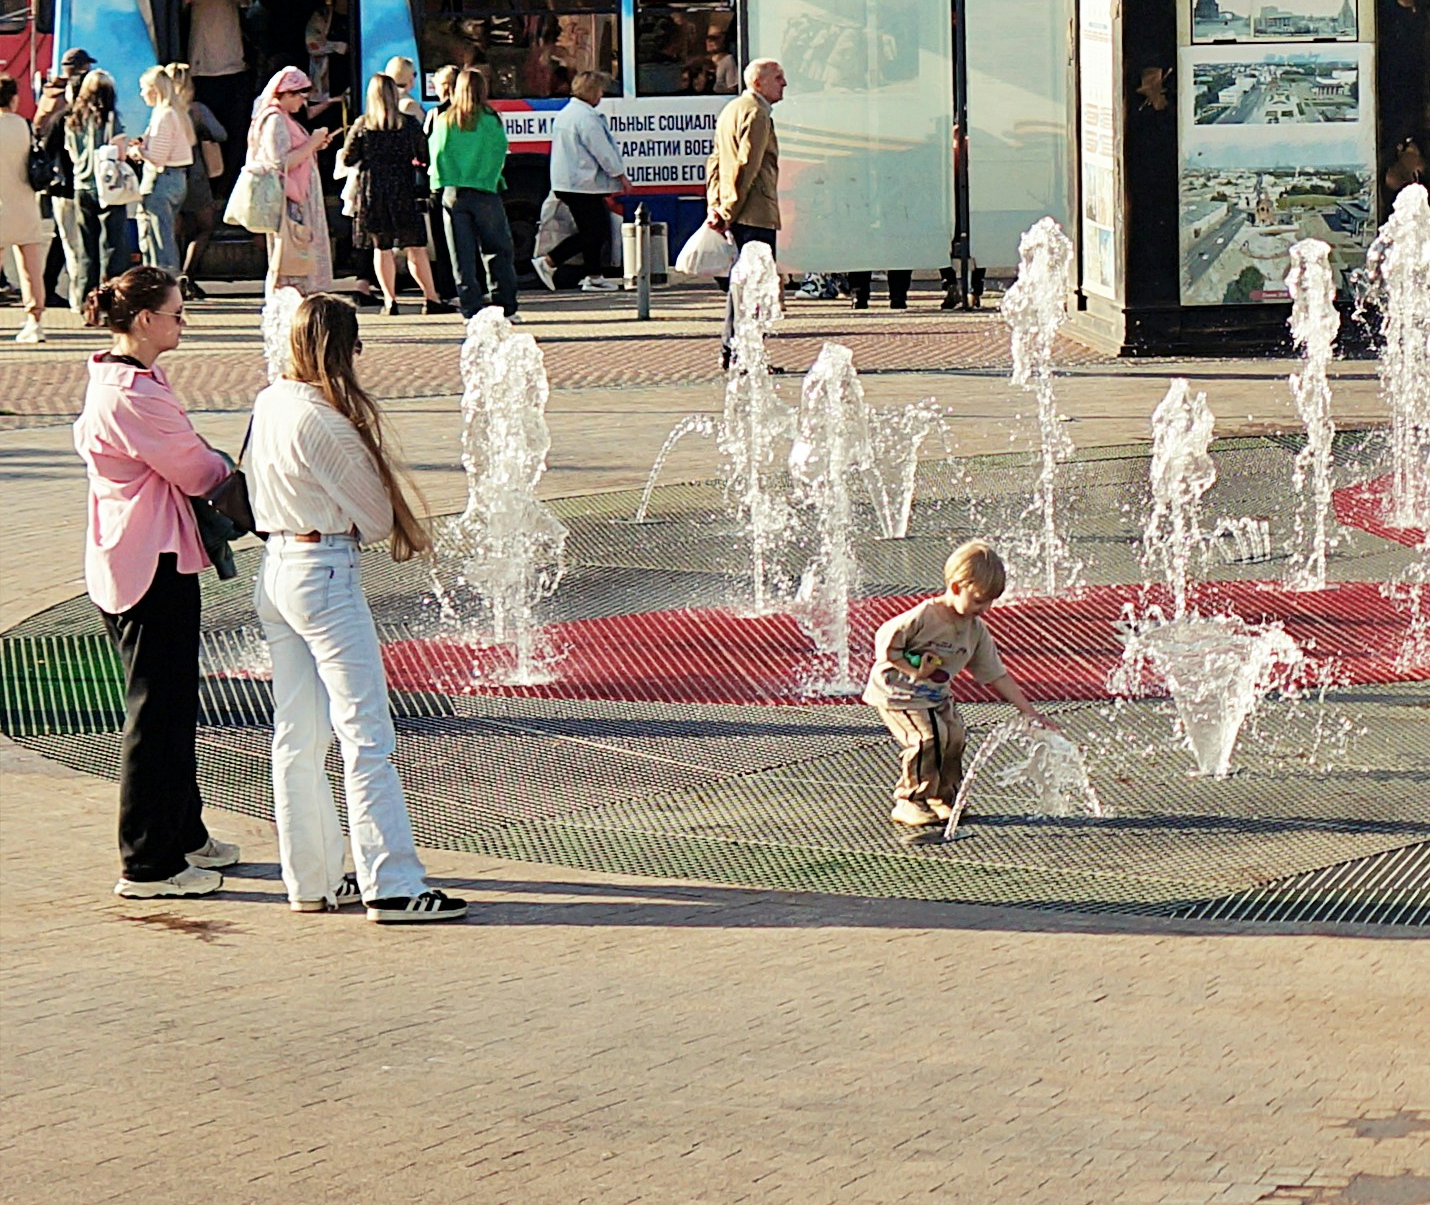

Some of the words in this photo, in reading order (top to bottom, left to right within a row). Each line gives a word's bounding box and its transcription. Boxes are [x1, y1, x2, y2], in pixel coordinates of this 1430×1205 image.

[538, 117, 547, 134] И
[617, 140, 681, 157] АРАНТИИ
[627, 165, 678, 182] ЧЛЕНОВ
[682, 165, 705, 181] ЕГО
